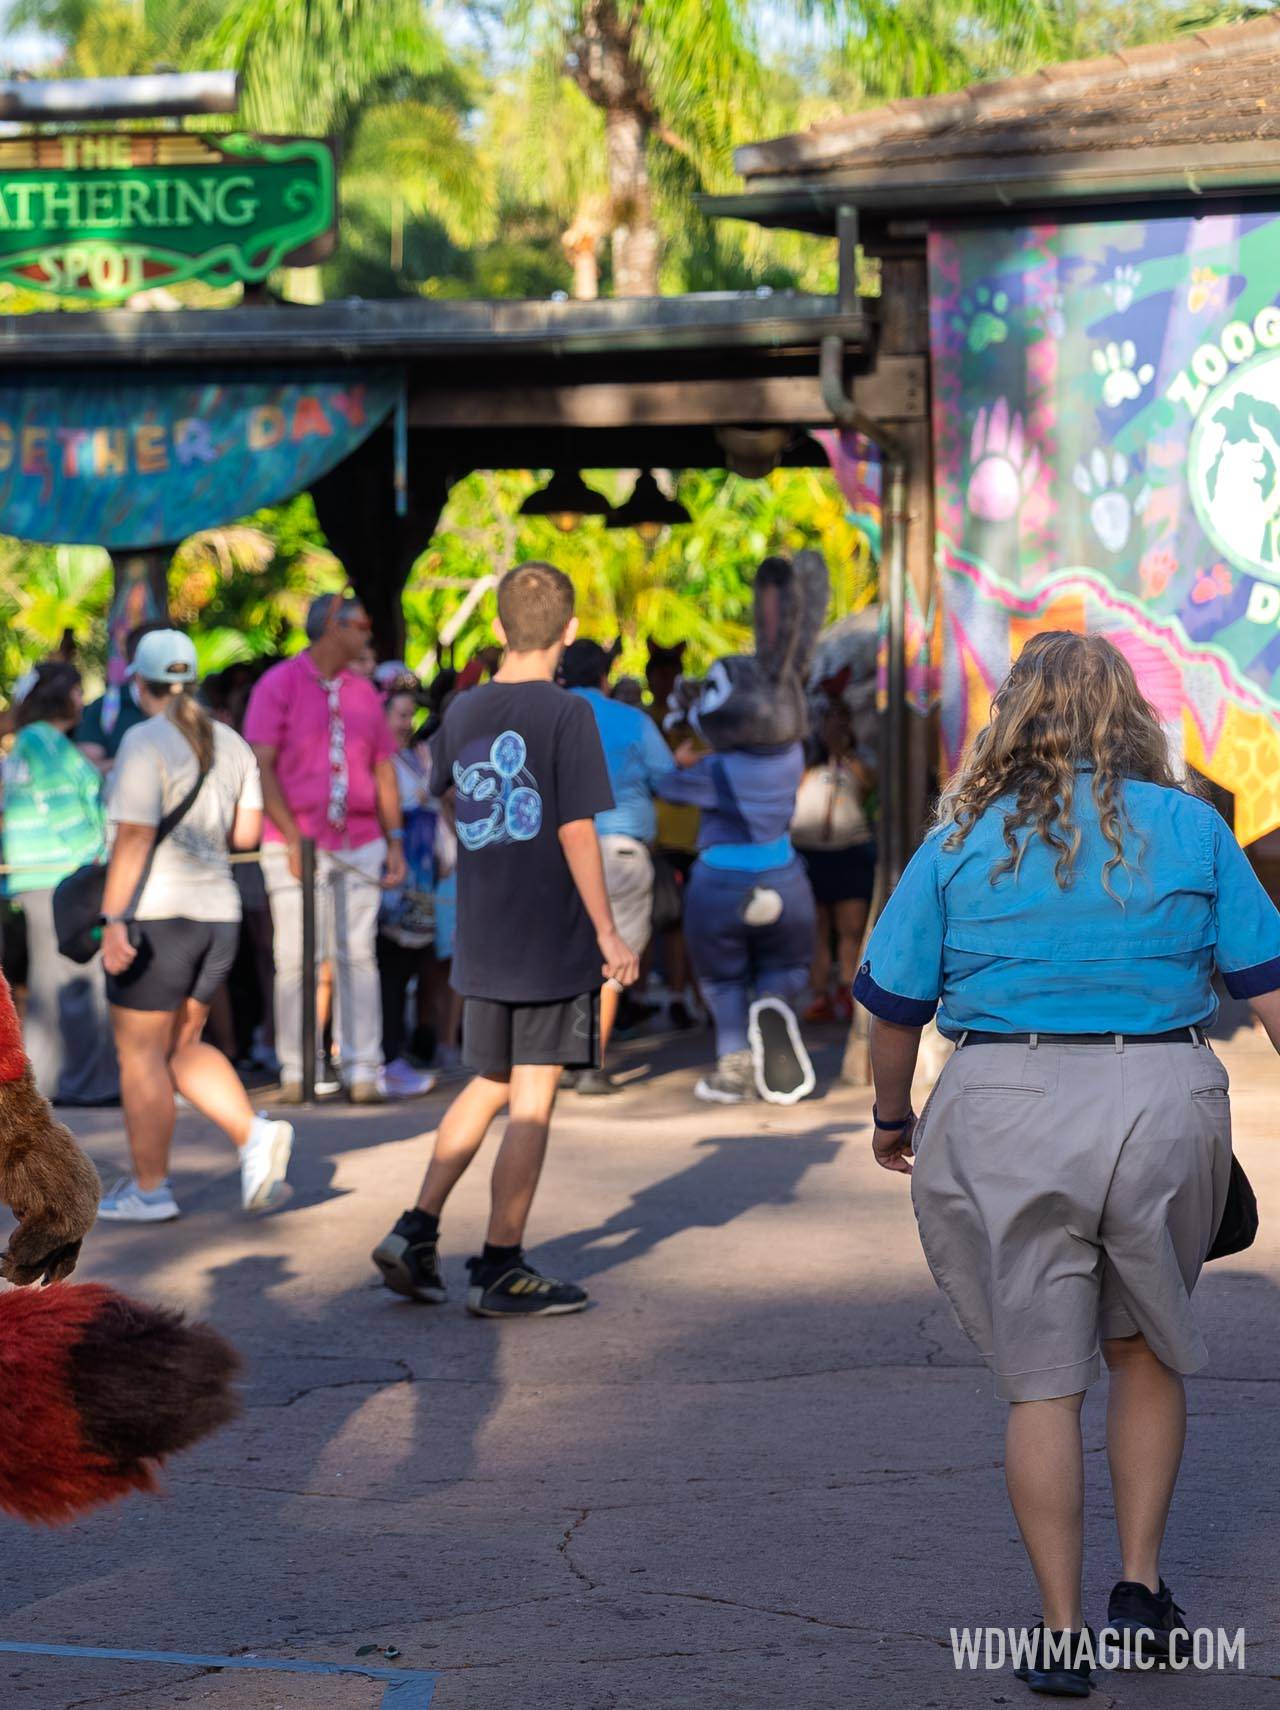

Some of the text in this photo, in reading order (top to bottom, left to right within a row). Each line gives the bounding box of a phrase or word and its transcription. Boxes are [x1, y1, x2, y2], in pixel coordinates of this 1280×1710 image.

[62, 136, 132, 170] THE
[38, 247, 150, 292] SPOT
[247, 384, 367, 452] DAY
[1245, 581, 1280, 625] D
